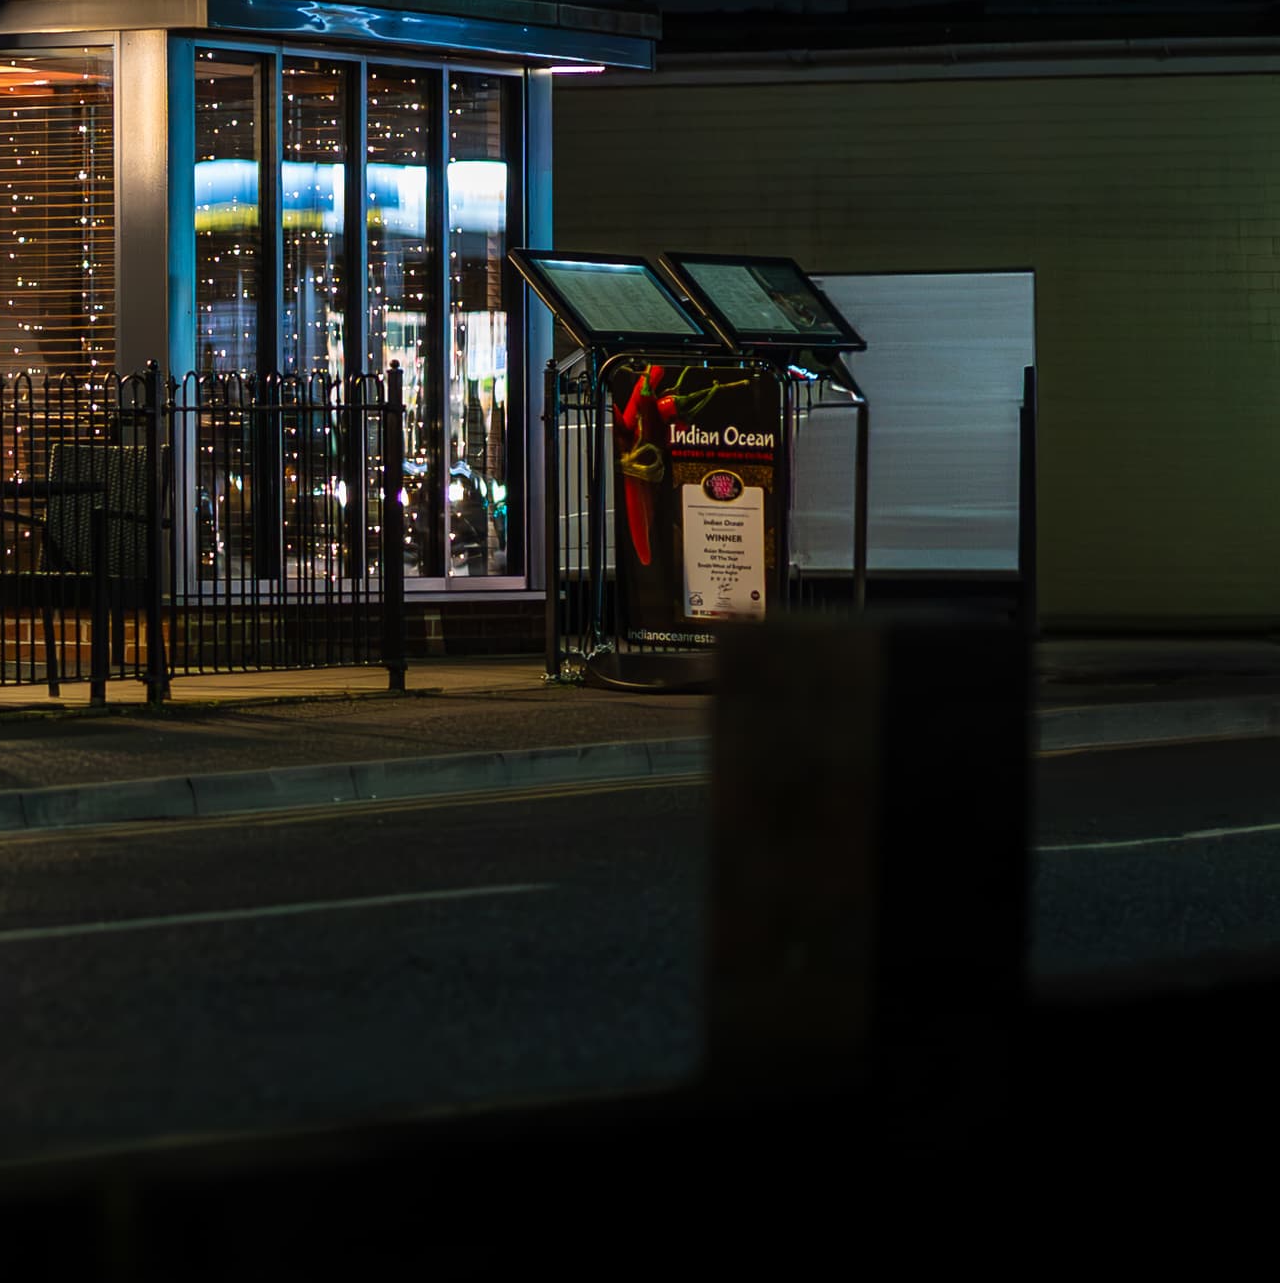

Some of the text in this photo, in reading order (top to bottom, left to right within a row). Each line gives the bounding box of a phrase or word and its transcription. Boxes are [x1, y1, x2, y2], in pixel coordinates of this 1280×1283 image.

[669, 424, 775, 448] Indian Ocean
[705, 533, 742, 543] WINNER
